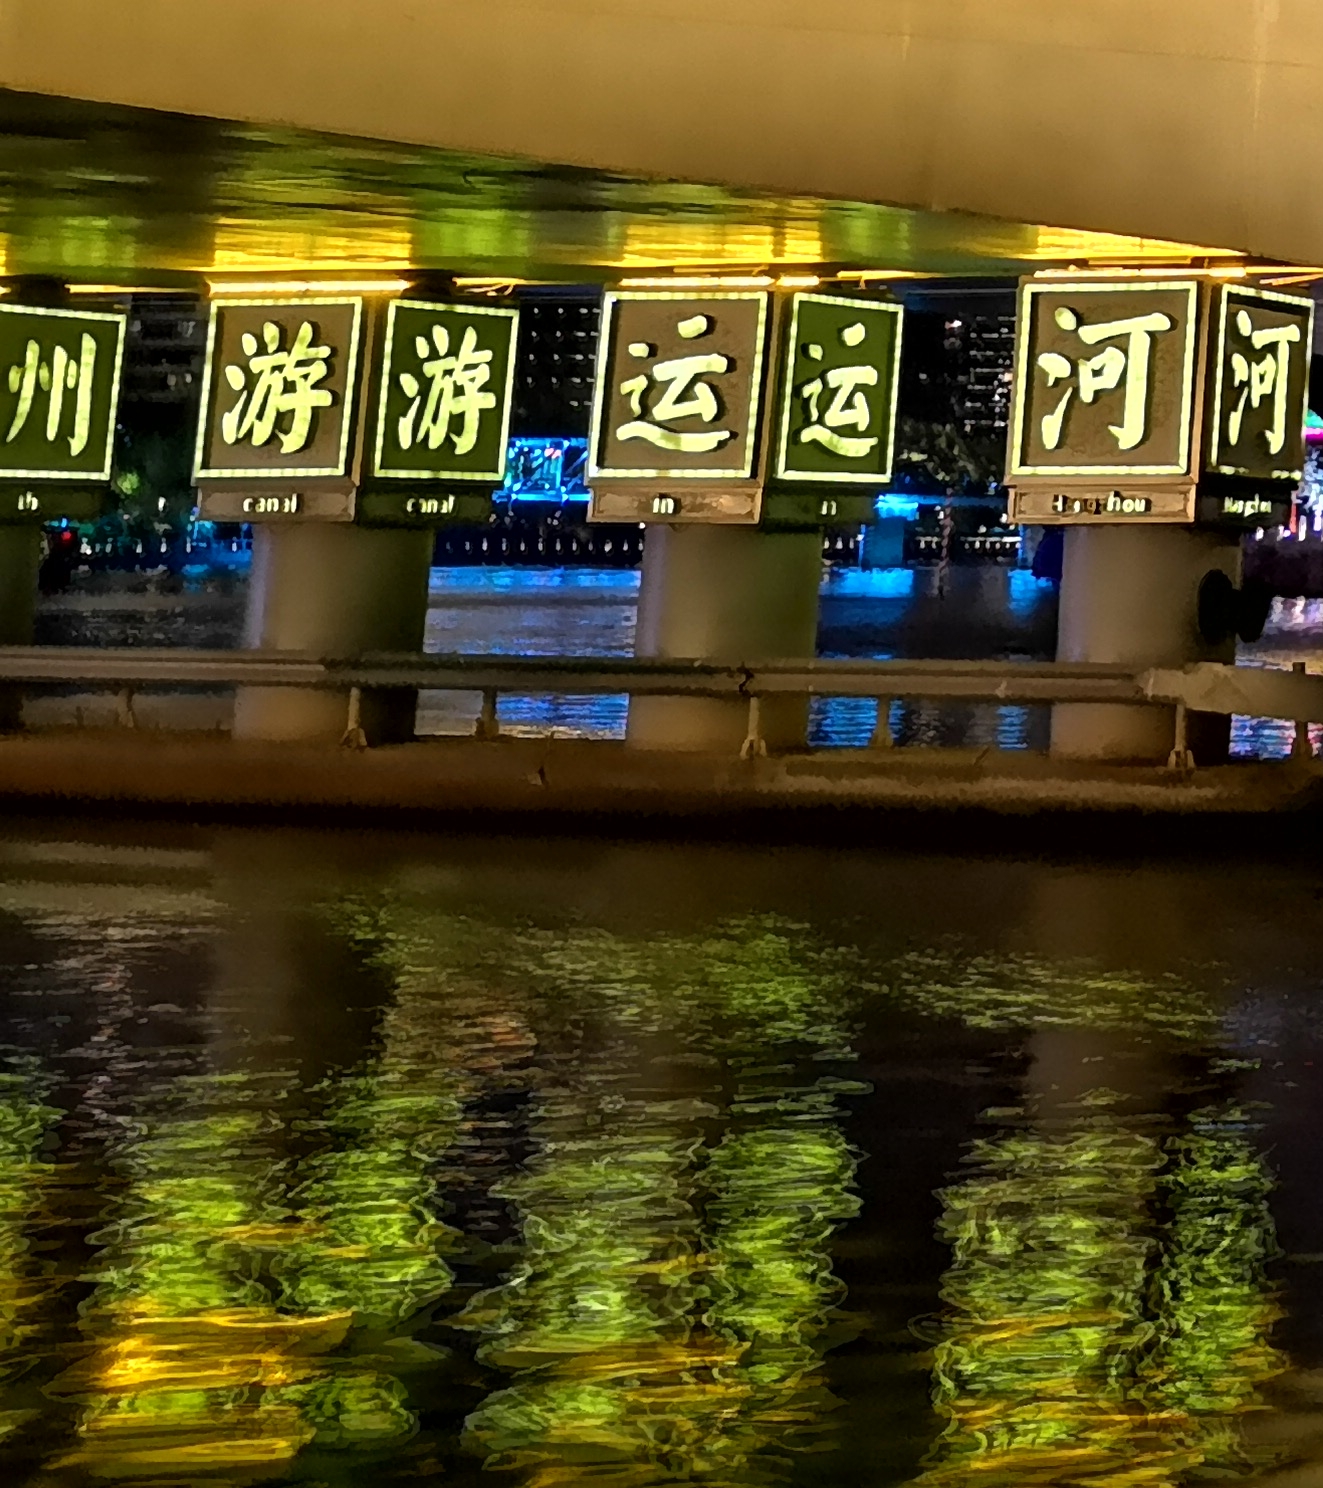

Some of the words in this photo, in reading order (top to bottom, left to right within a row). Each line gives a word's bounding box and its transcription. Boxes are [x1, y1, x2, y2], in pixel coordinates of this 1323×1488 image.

[7, 333, 98, 456] 州
[222, 321, 332, 453] 游
[398, 324, 496, 454] 游
[616, 315, 731, 452] 运
[801, 323, 879, 457] 运
[1037, 308, 1171, 449] 河
[1230, 310, 1300, 454] 河
[242, 493, 297, 513] canal
